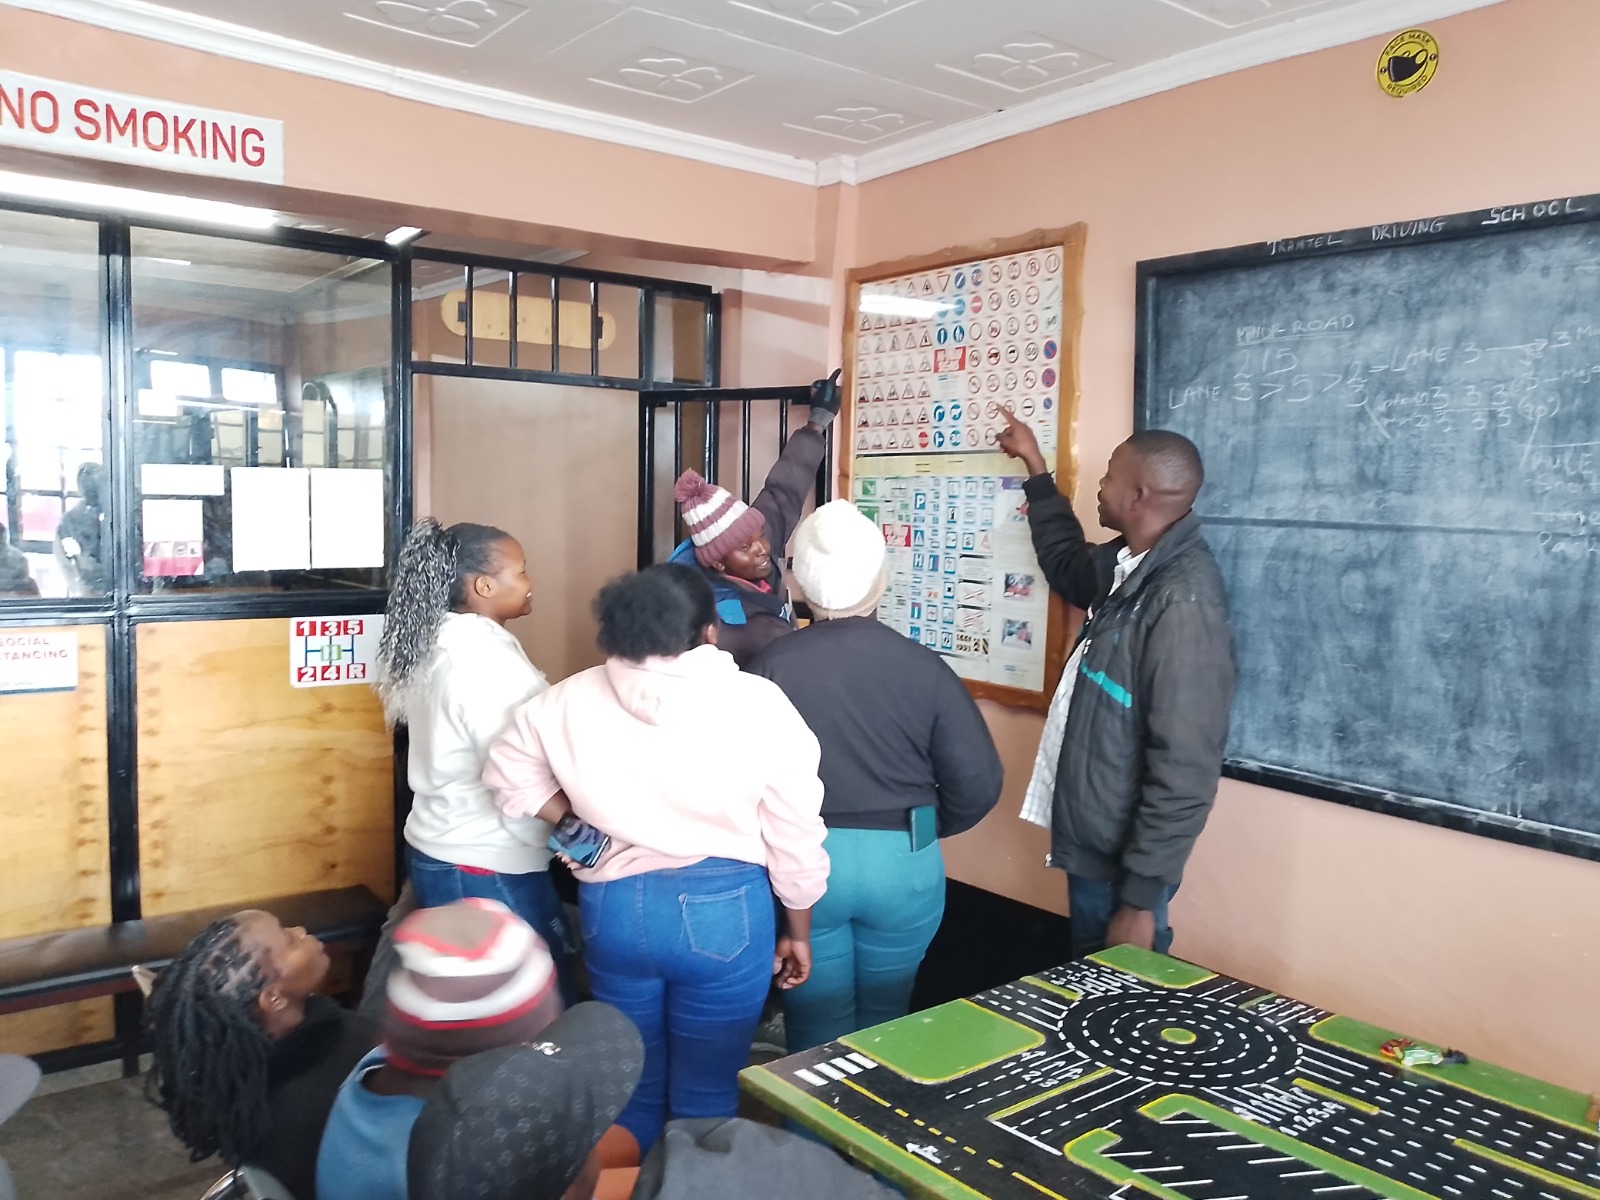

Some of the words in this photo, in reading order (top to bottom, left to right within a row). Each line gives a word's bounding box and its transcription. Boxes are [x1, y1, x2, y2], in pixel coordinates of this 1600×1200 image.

[0, 84, 59, 134] NO
[74, 98, 266, 167] SMOKING
[1371, 218, 1447, 242] DRIVING
[1481, 198, 1586, 225] SCHOOL
[1292, 314, 1355, 334] ROAD
[299, 621, 310, 636] 1
[324, 621, 338, 636] 3
[347, 620, 361, 635] 5
[0, 637, 49, 647] SOCIAL
[0, 649, 68, 661] TANCING
[300, 667, 315, 682] 2
[323, 666, 338, 680] 4
[349, 664, 364, 679] R
